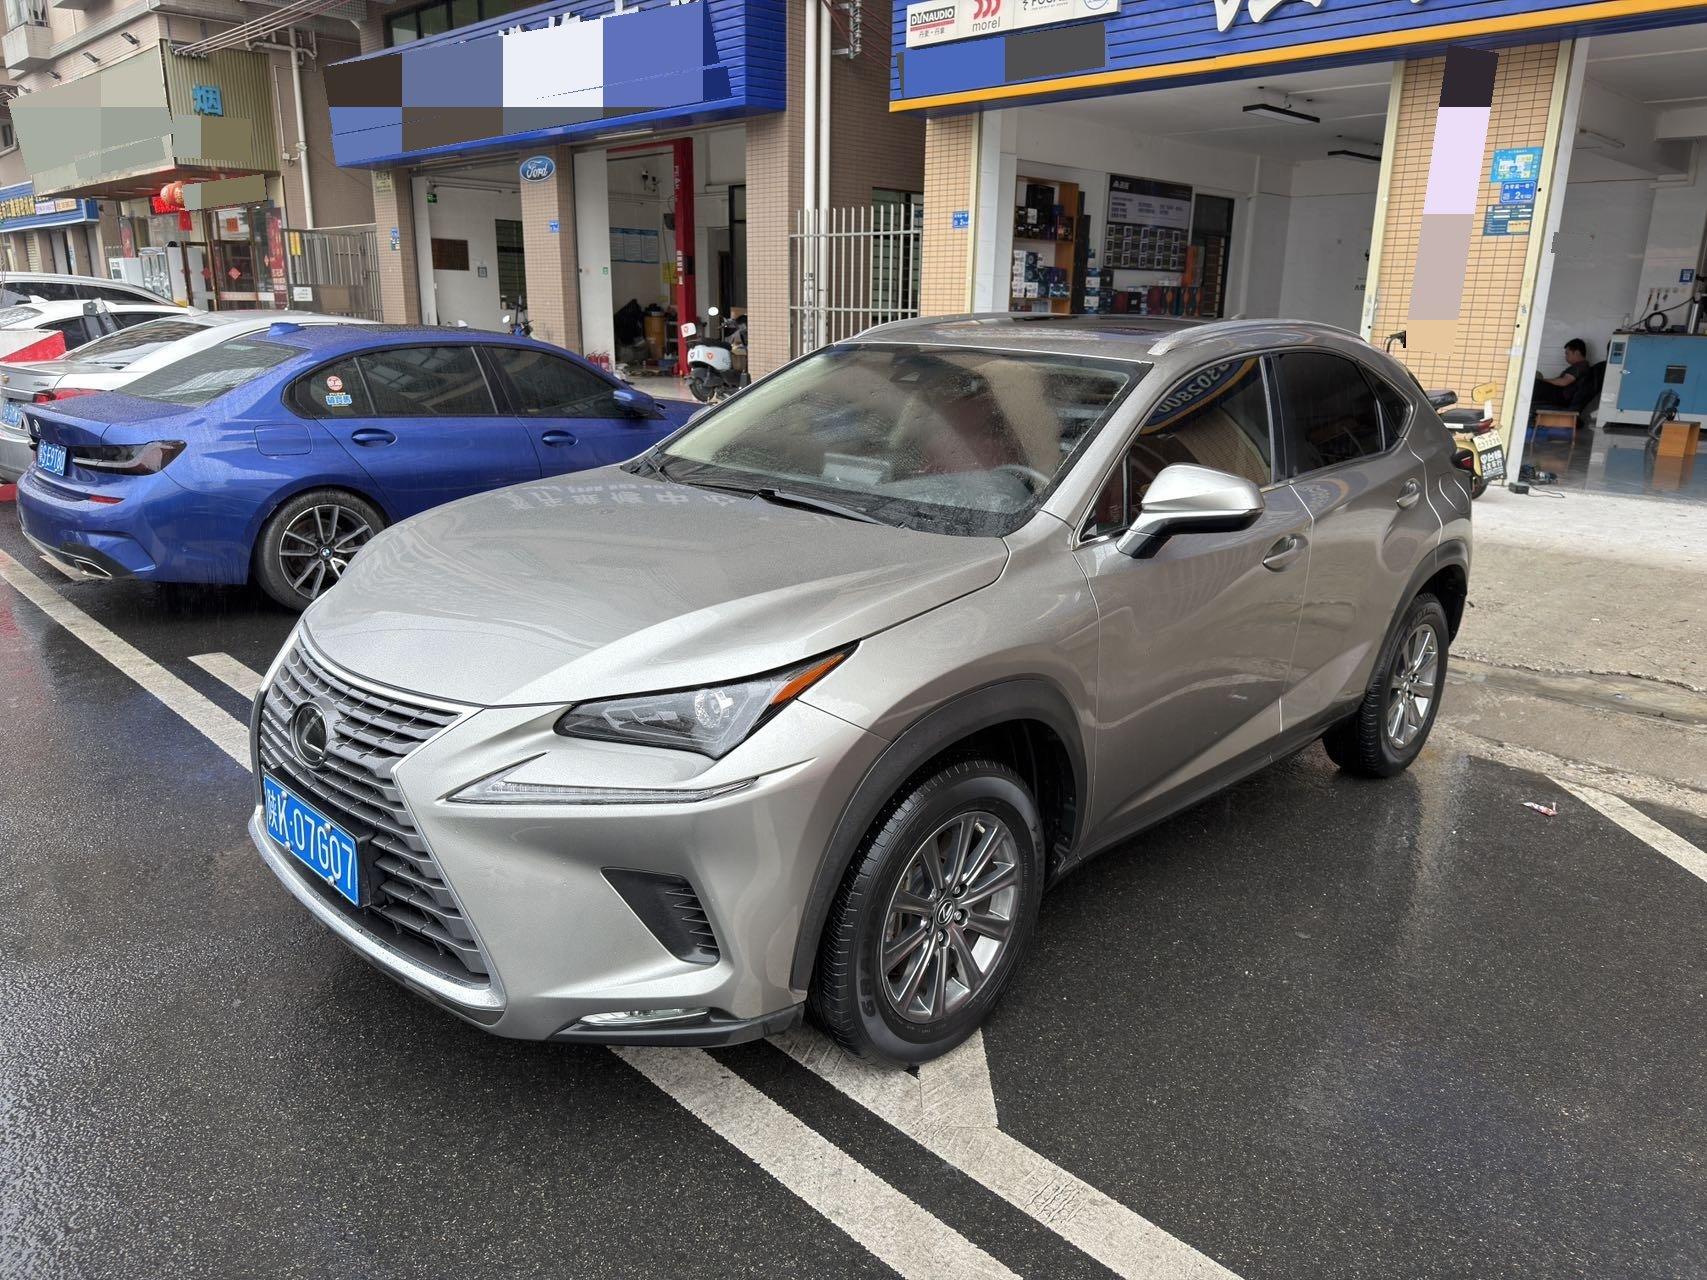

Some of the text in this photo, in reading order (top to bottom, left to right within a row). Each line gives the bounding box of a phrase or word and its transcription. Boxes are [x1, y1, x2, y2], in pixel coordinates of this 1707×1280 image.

[911, 7, 954, 25] DYNAUDIO
[973, 17, 1000, 32] morel
[192, 84, 224, 116] 烟
